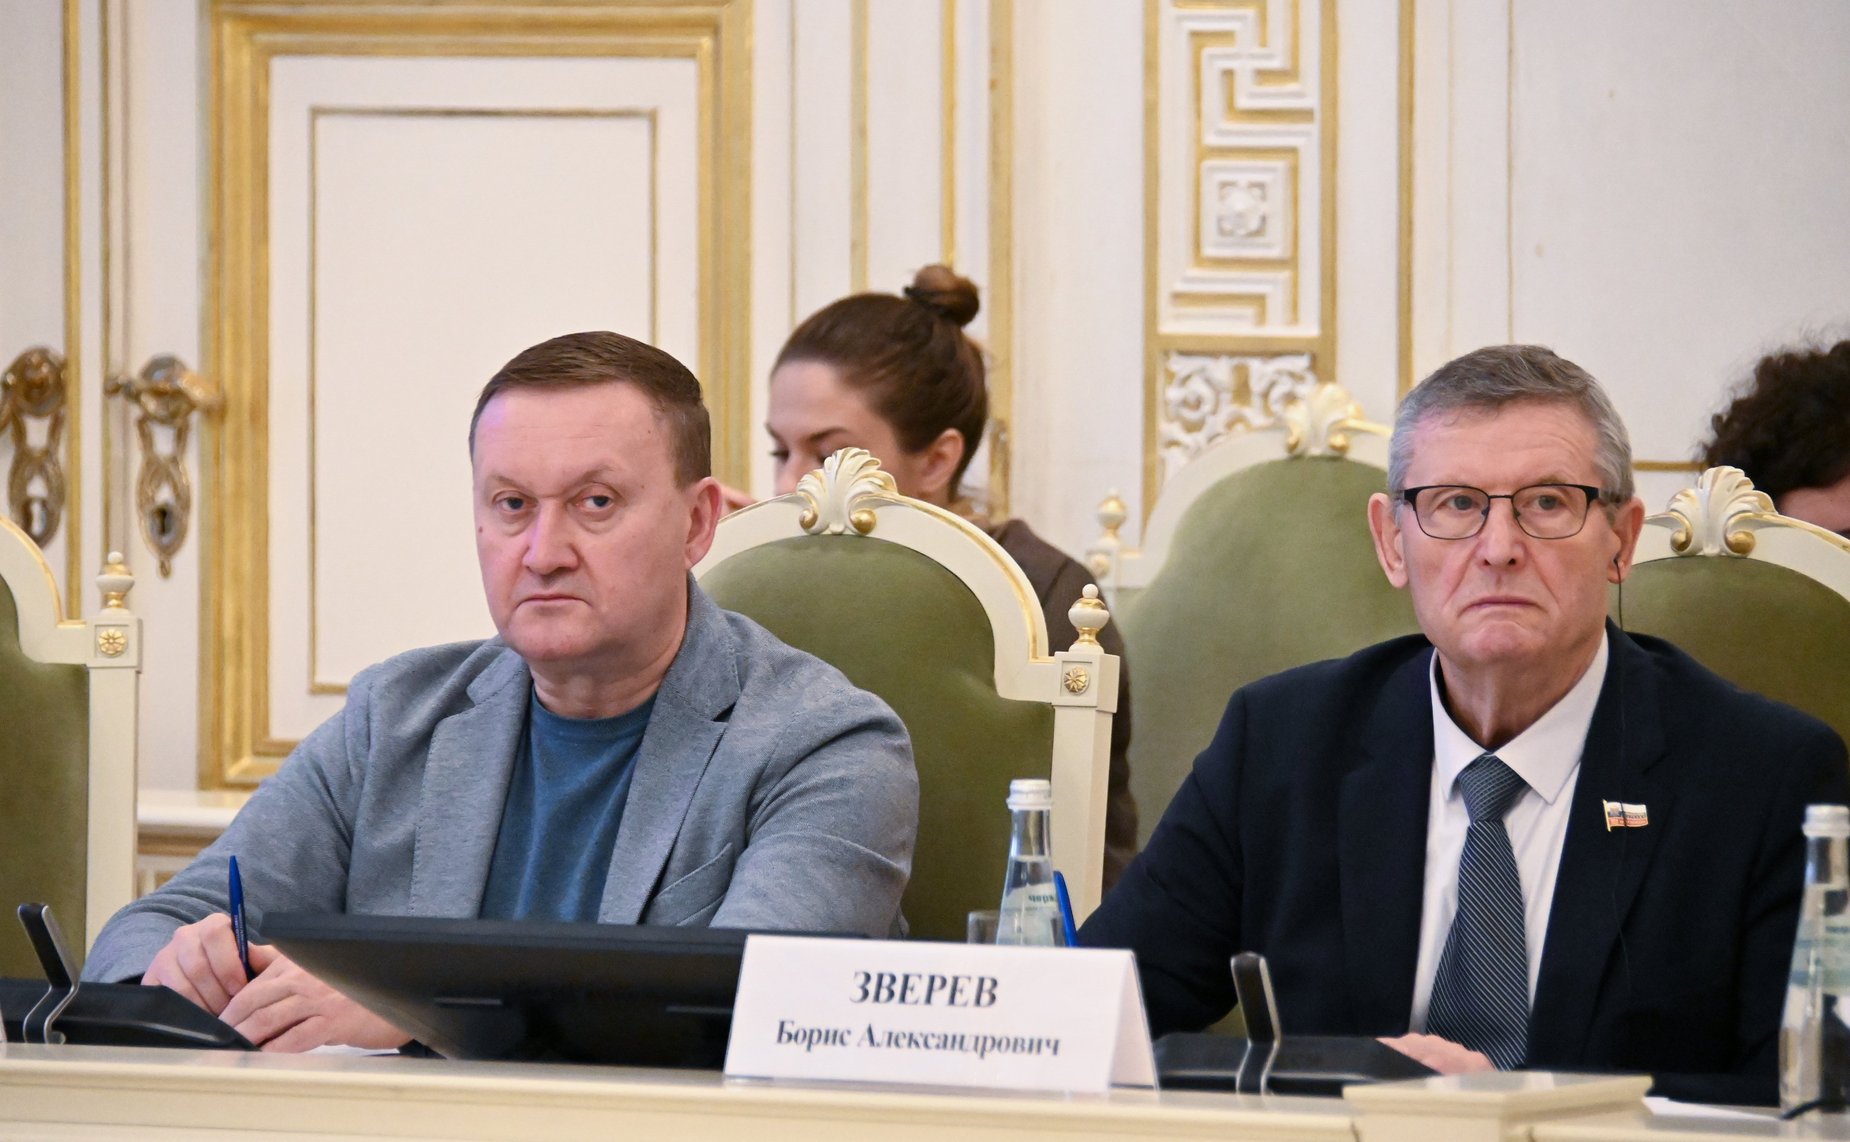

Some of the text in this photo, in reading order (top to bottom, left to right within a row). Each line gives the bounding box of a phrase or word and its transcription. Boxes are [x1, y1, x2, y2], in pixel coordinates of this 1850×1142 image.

[849, 971, 998, 1008] ЗВЕРЕВ
[776, 1019, 1061, 1059] Борис Александрович
